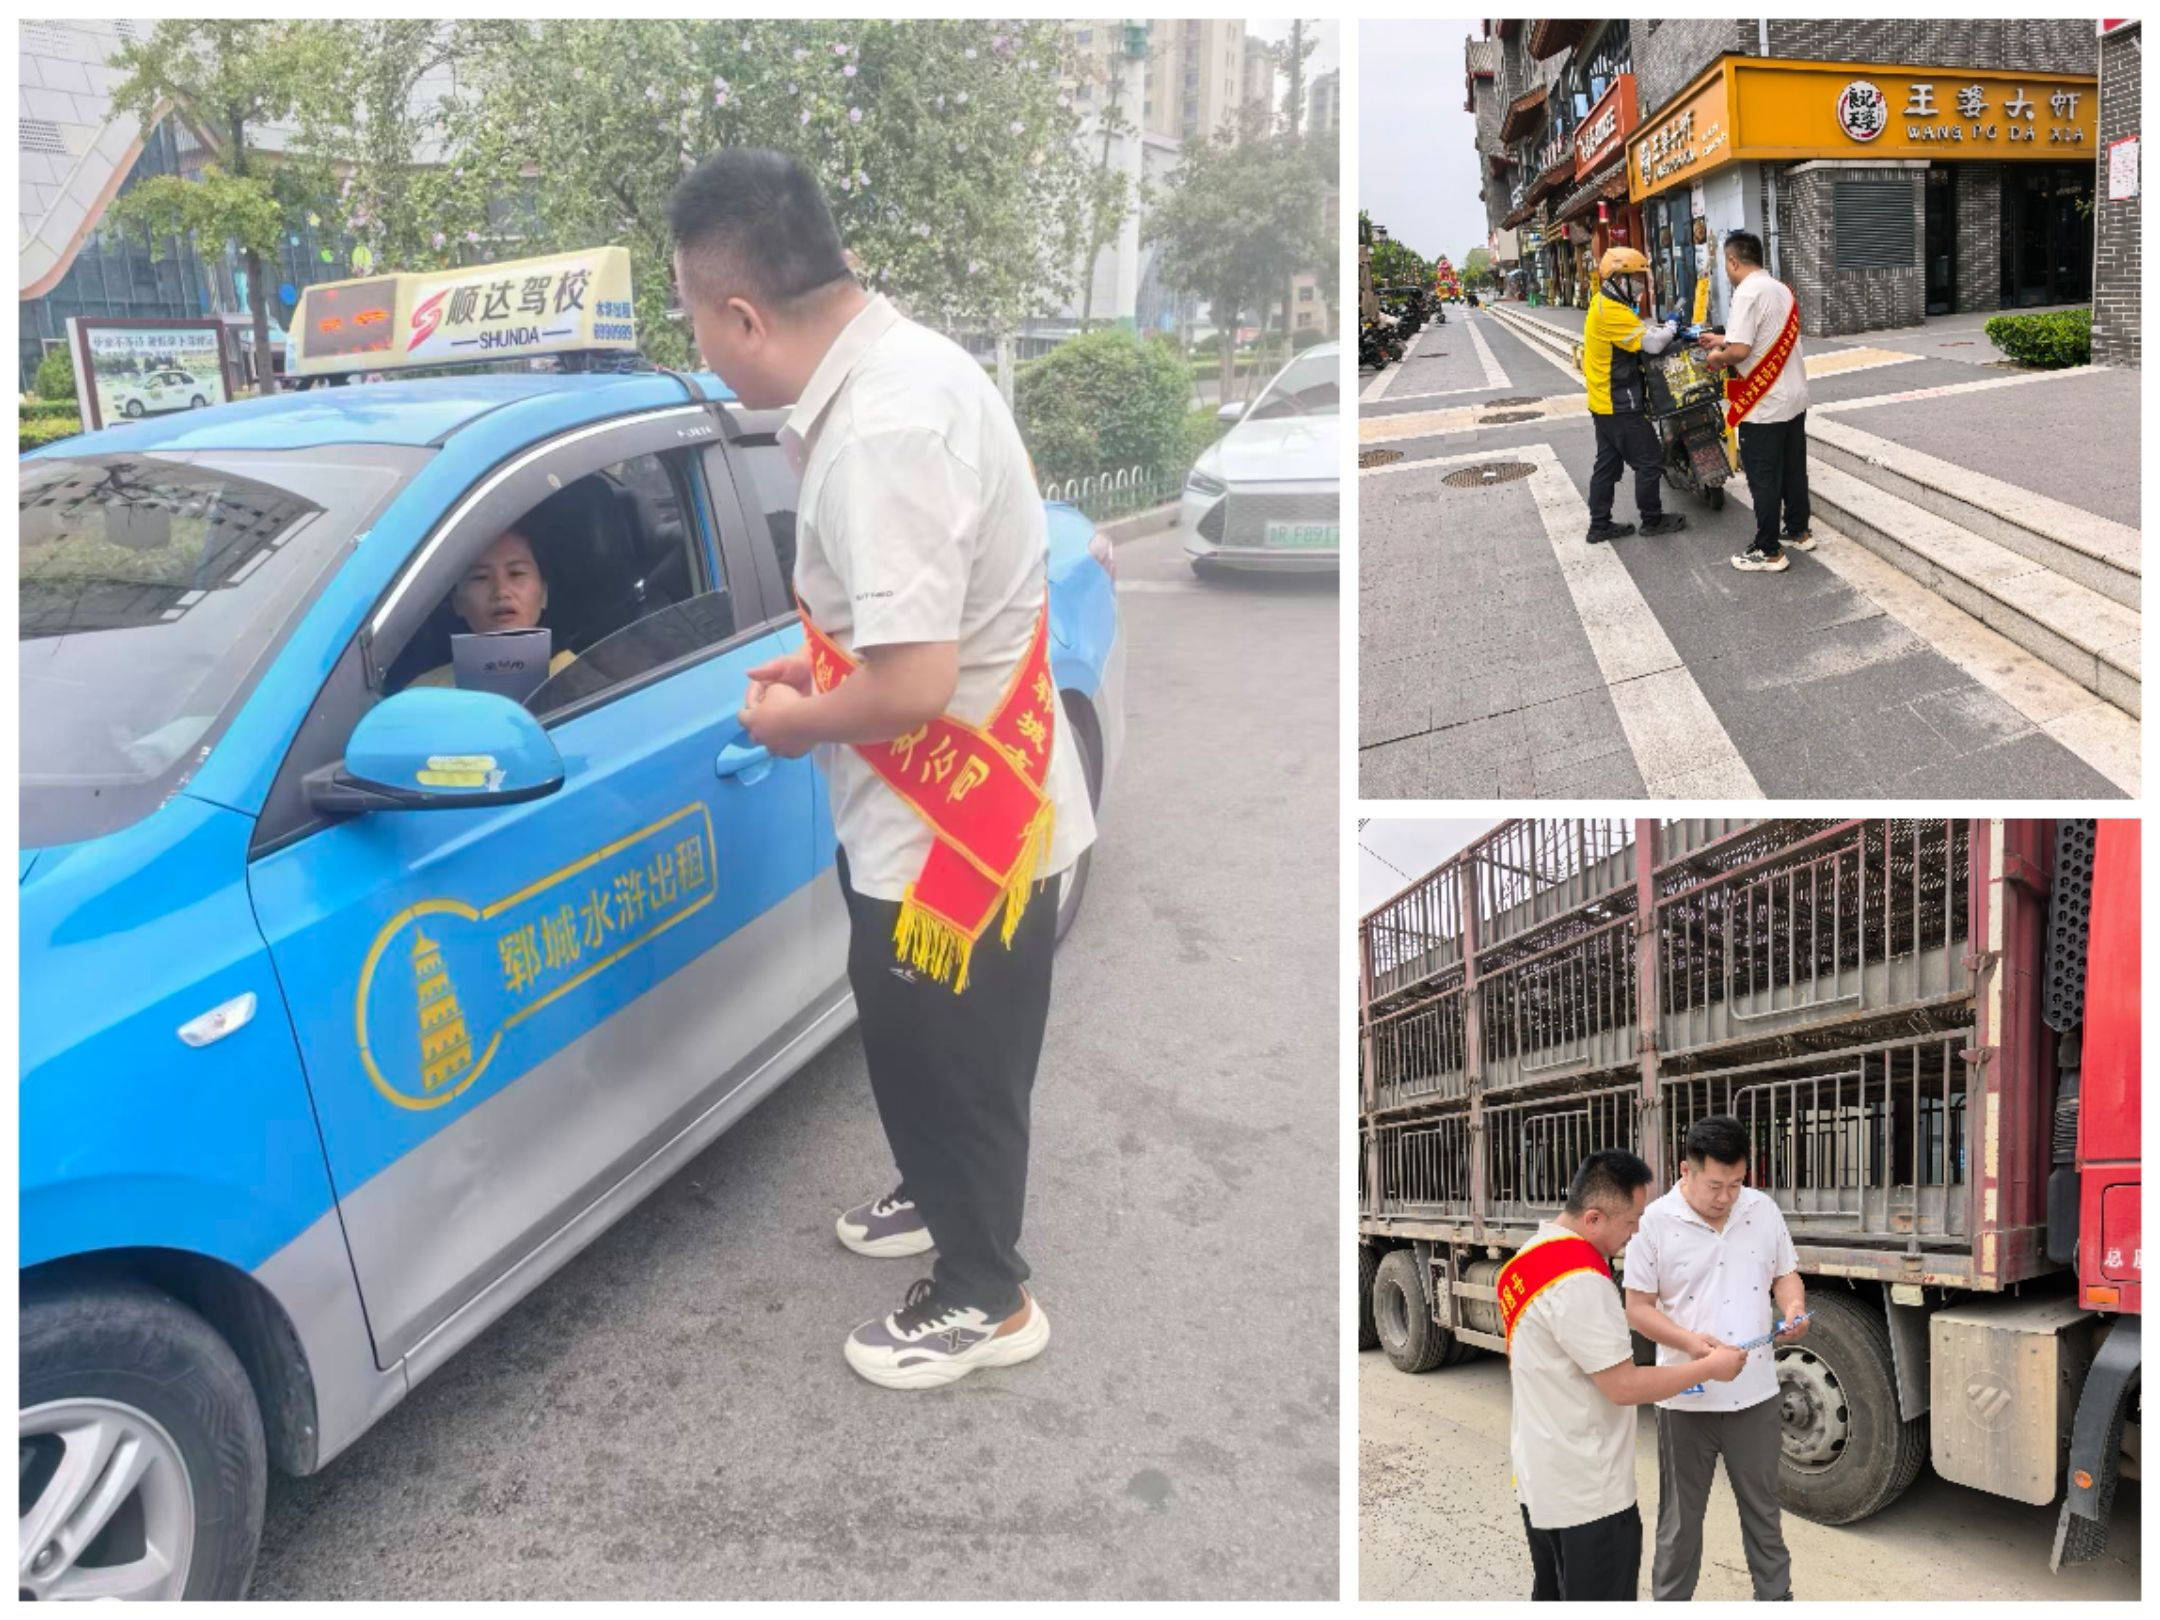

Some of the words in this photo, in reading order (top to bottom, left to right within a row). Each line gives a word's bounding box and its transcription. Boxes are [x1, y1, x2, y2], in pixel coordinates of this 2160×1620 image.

[1903, 83, 2083, 120] 王婆大虾
[1907, 124, 1964, 141] WANG
[2010, 125, 2035, 140] DA
[2049, 126, 2084, 142] XIA
[445, 268, 592, 327] 顺达驾校
[479, 326, 540, 350] SHUNDA
[497, 834, 705, 993] 郓城水浒出租
